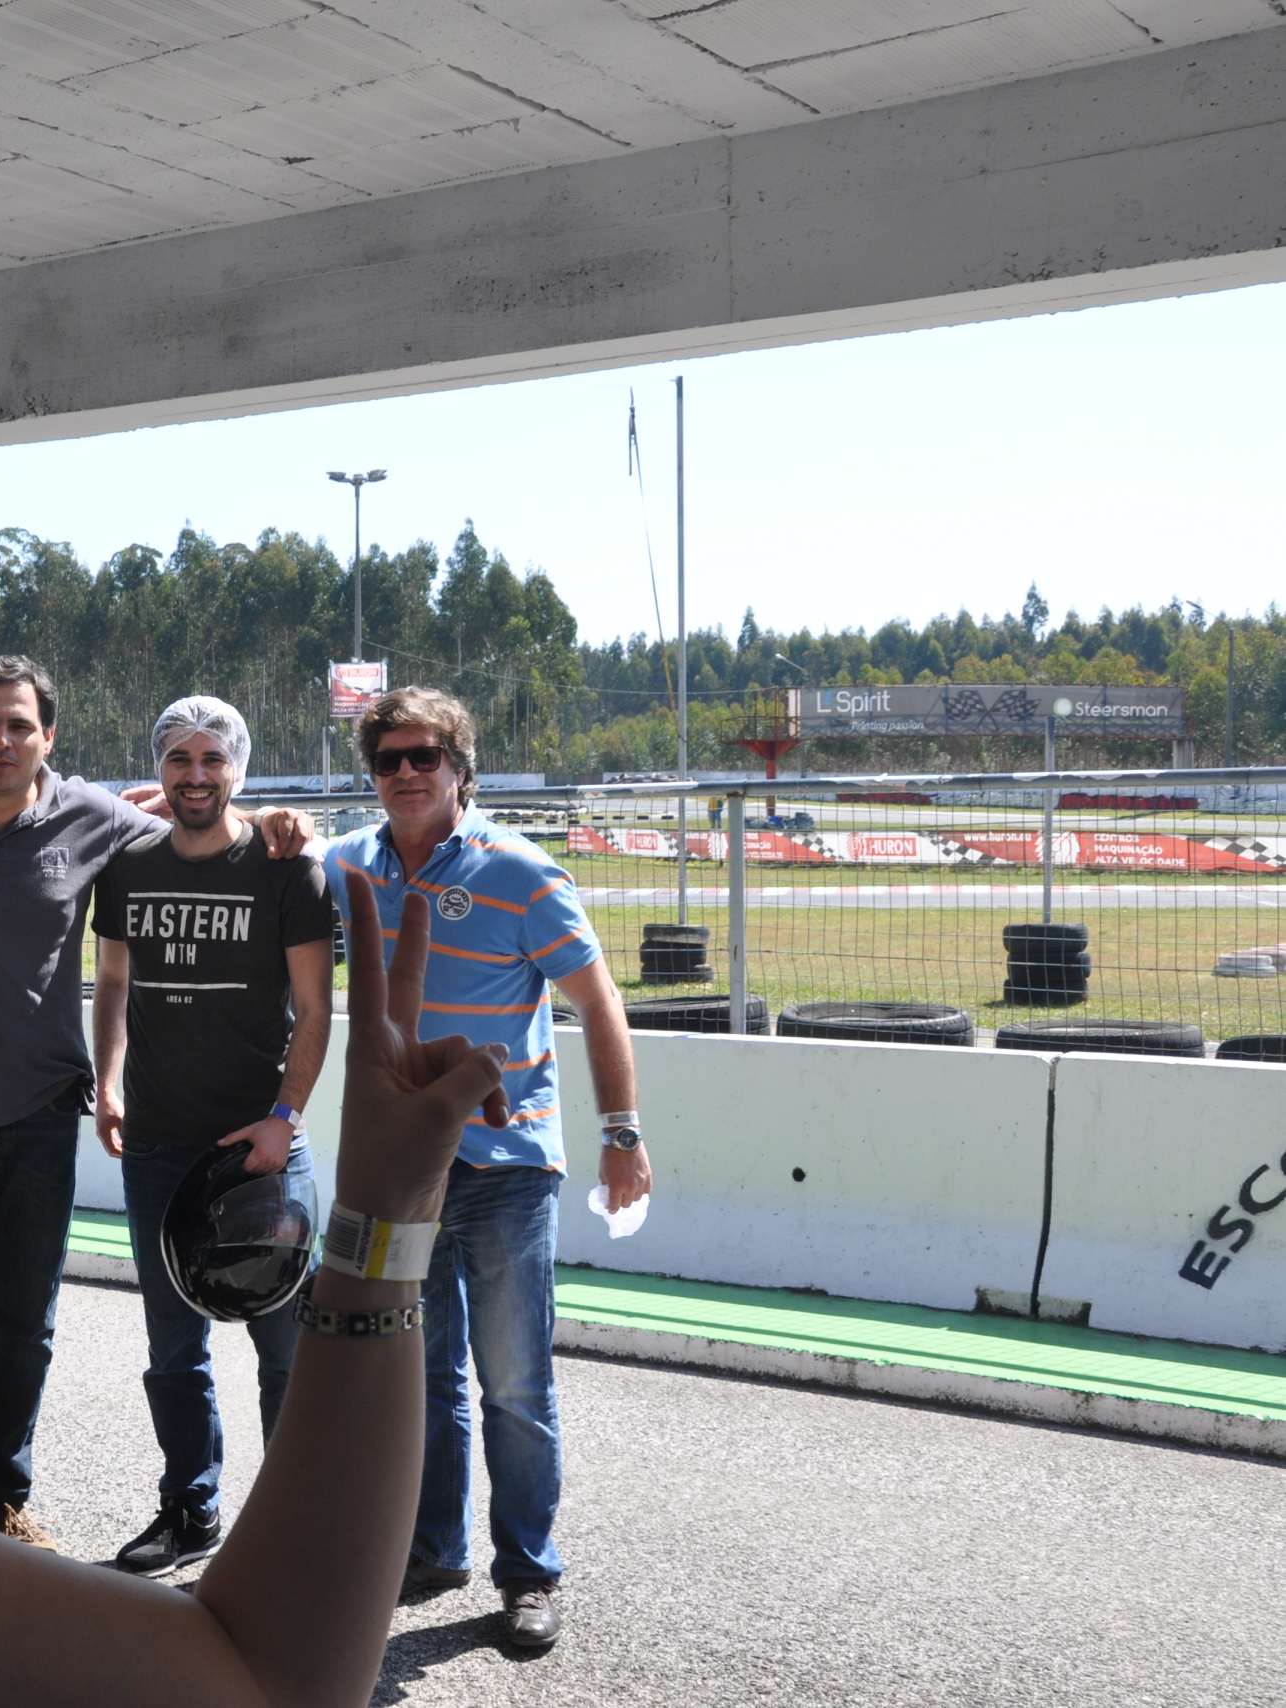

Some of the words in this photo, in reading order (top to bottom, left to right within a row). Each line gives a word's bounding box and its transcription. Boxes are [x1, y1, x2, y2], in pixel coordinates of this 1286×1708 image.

[836, 690, 891, 717] Spirit
[1075, 702, 1168, 717] Steersman
[870, 839, 914, 855] HURON
[1121, 857, 1187, 867] VEOCDADE
[126, 904, 252, 941] EASTERN
[164, 942, 196, 965] NTH
